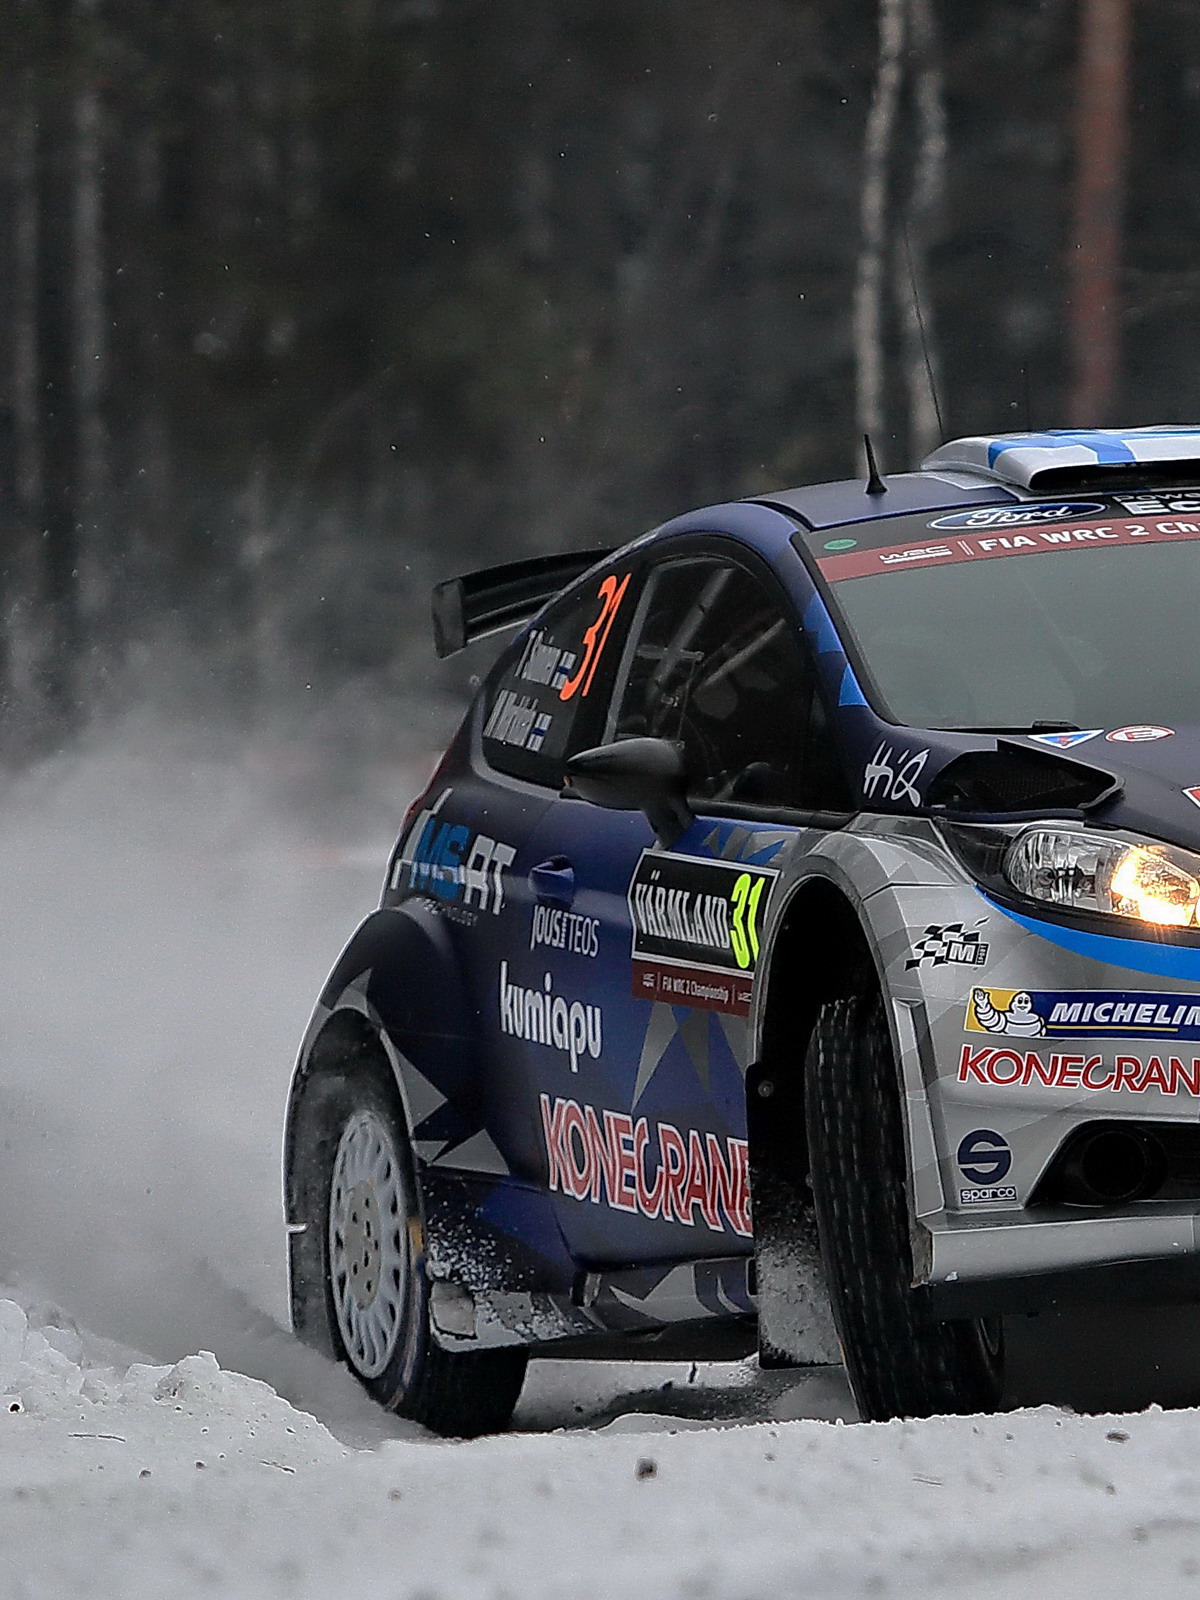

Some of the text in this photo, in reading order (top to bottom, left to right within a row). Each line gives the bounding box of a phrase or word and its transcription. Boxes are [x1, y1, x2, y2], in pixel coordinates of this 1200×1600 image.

[965, 506, 1072, 526] Ford
[978, 535, 1038, 551] FIA
[1039, 526, 1120, 544] WRC
[1124, 525, 1150, 537] 2
[559, 573, 632, 701] 31
[635, 869, 766, 968] VÄRMLAND 31
[948, 943, 977, 963] M
[500, 960, 602, 1073] kumiapu
[538, 1092, 754, 1239] KONECRANE
[961, 1187, 1015, 1203] sparco
